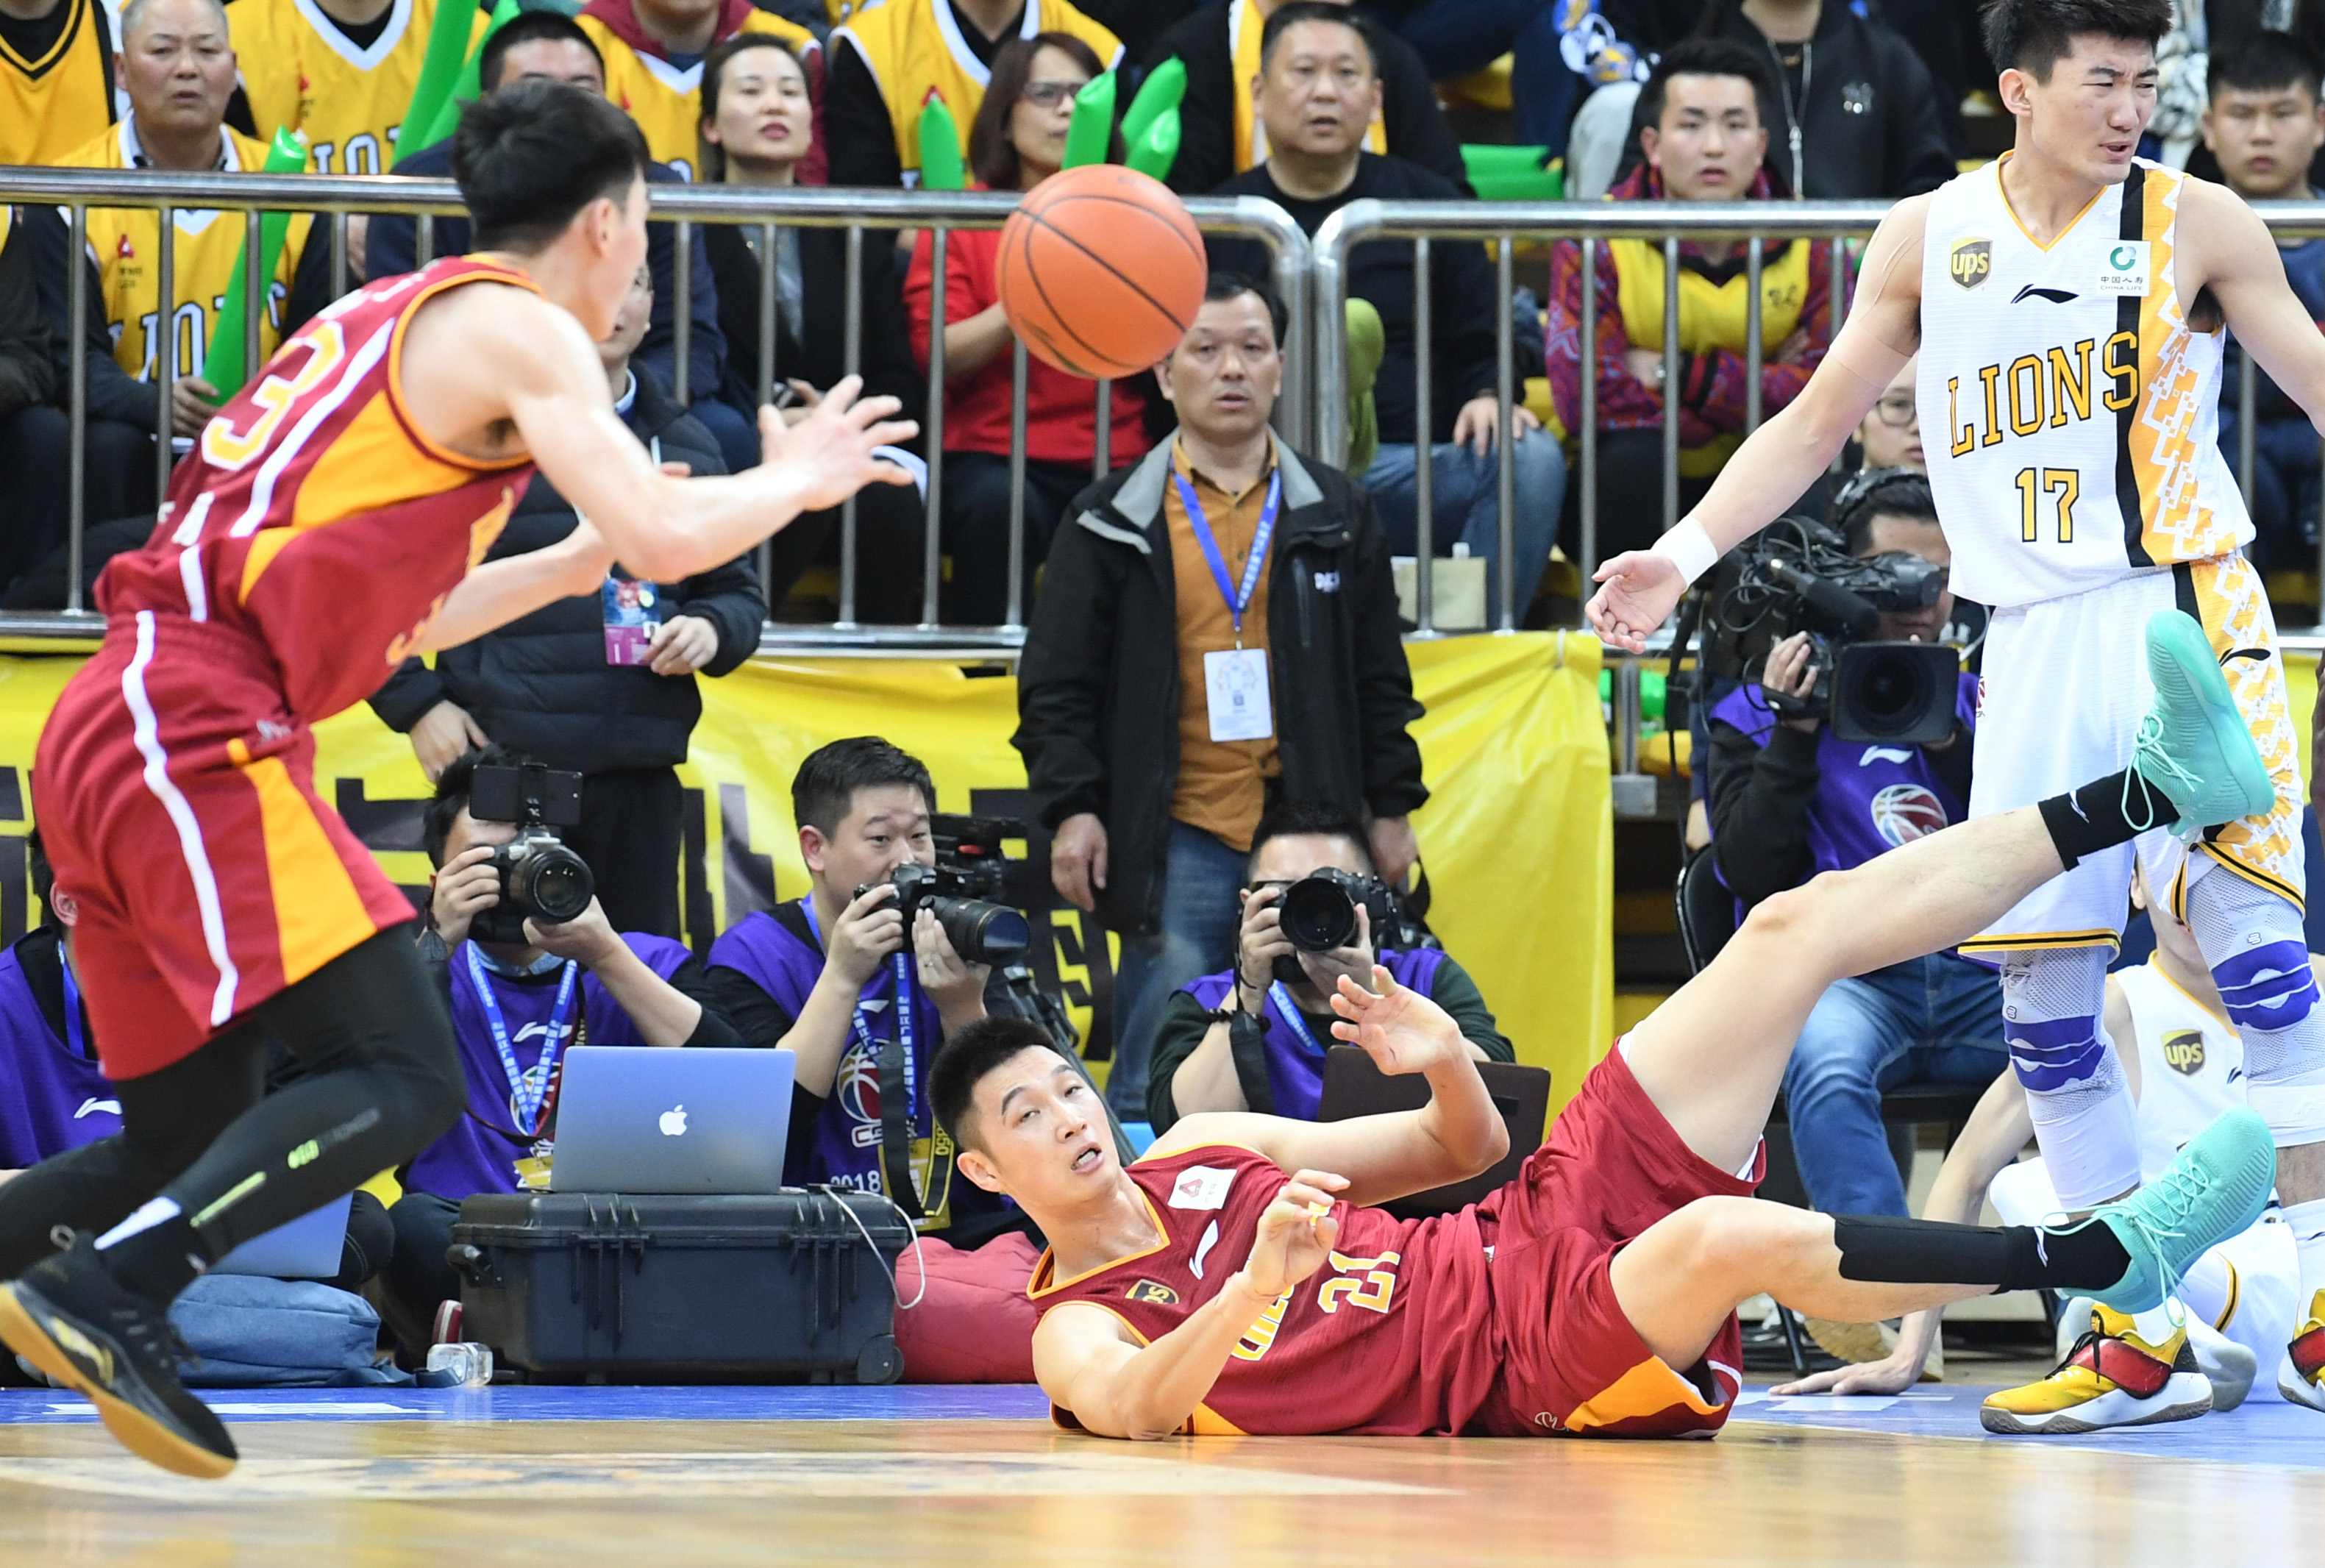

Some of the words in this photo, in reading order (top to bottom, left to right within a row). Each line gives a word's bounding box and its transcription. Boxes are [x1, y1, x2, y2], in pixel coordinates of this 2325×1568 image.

[1952, 252, 1989, 282] ups
[2100, 276, 2143, 285] 中国人寿
[1948, 330, 2139, 459] LIONS
[2015, 467, 2079, 543] 17
[2165, 1042, 2203, 1072] ups
[1317, 1250, 1400, 1314] 21
